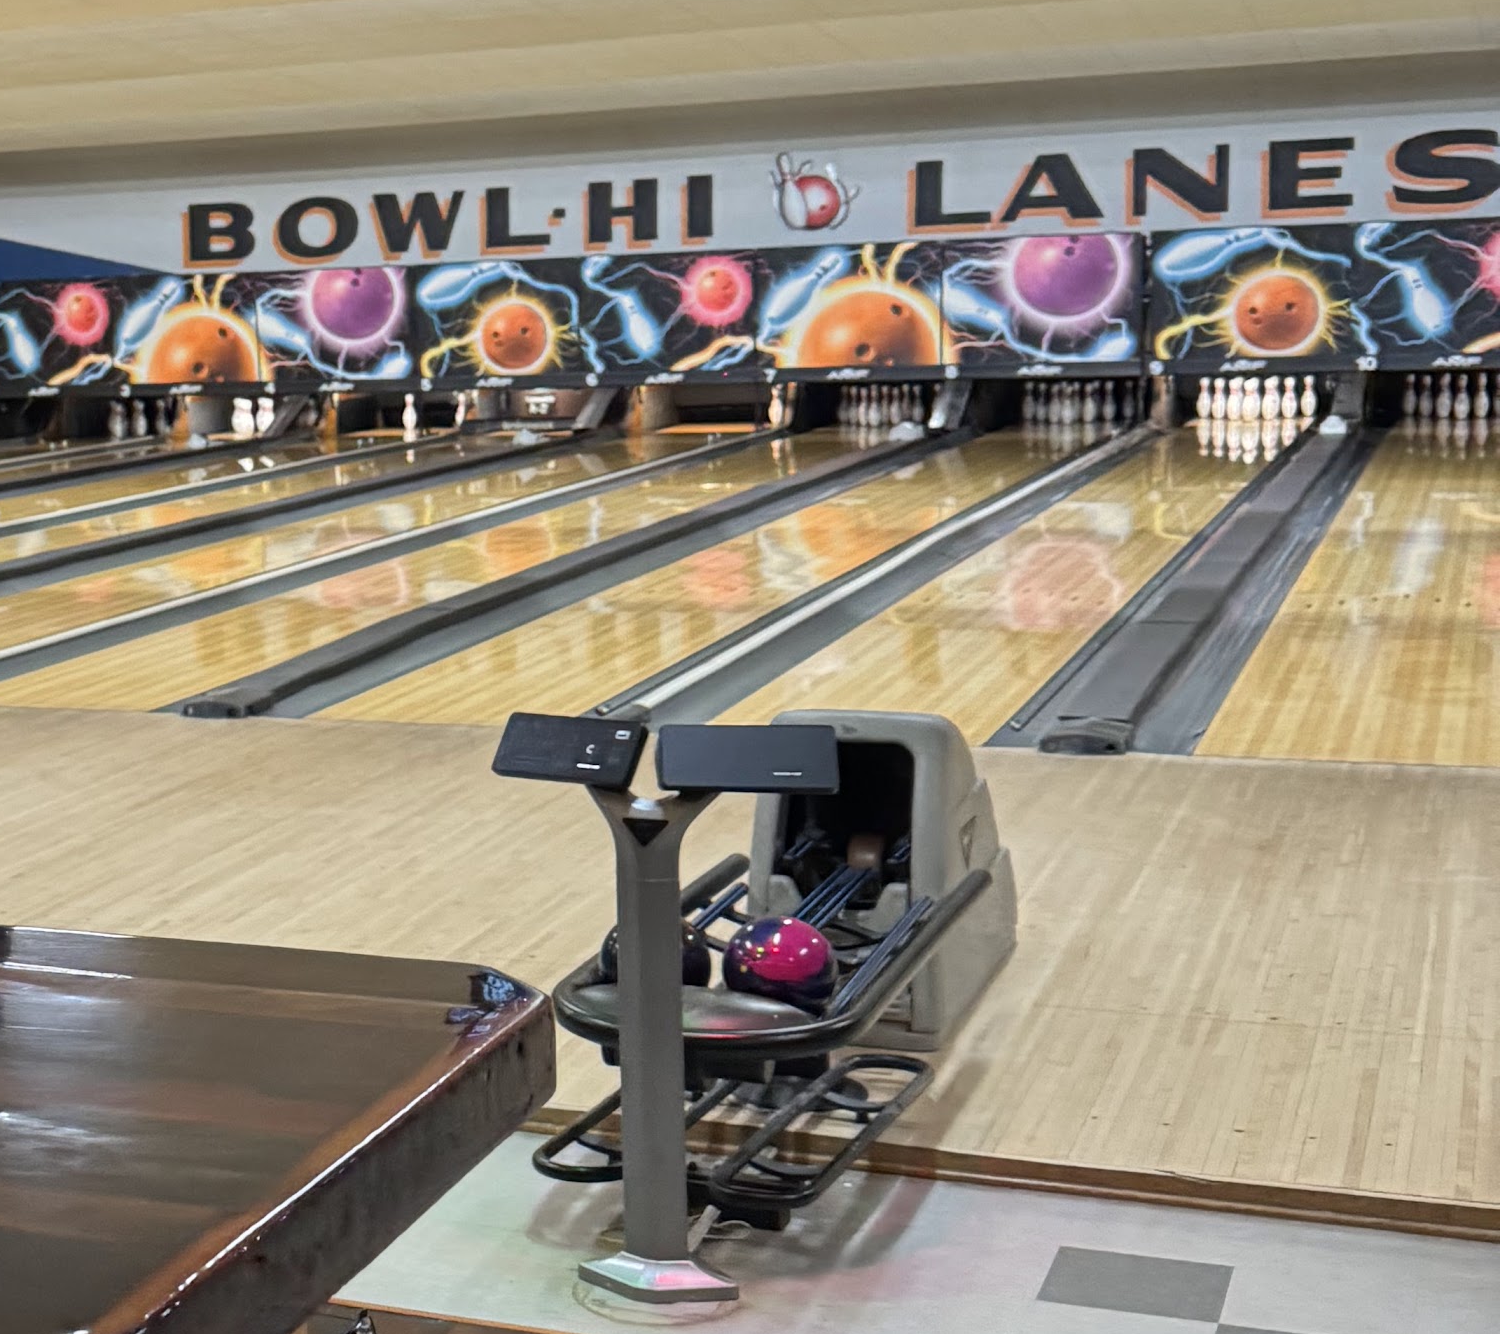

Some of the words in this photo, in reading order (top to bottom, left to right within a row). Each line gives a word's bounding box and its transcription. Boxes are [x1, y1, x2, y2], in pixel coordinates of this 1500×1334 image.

[906, 128, 1500, 235] LANES
[763, 368, 777, 383] 7
[1356, 356, 1377, 371] 10
